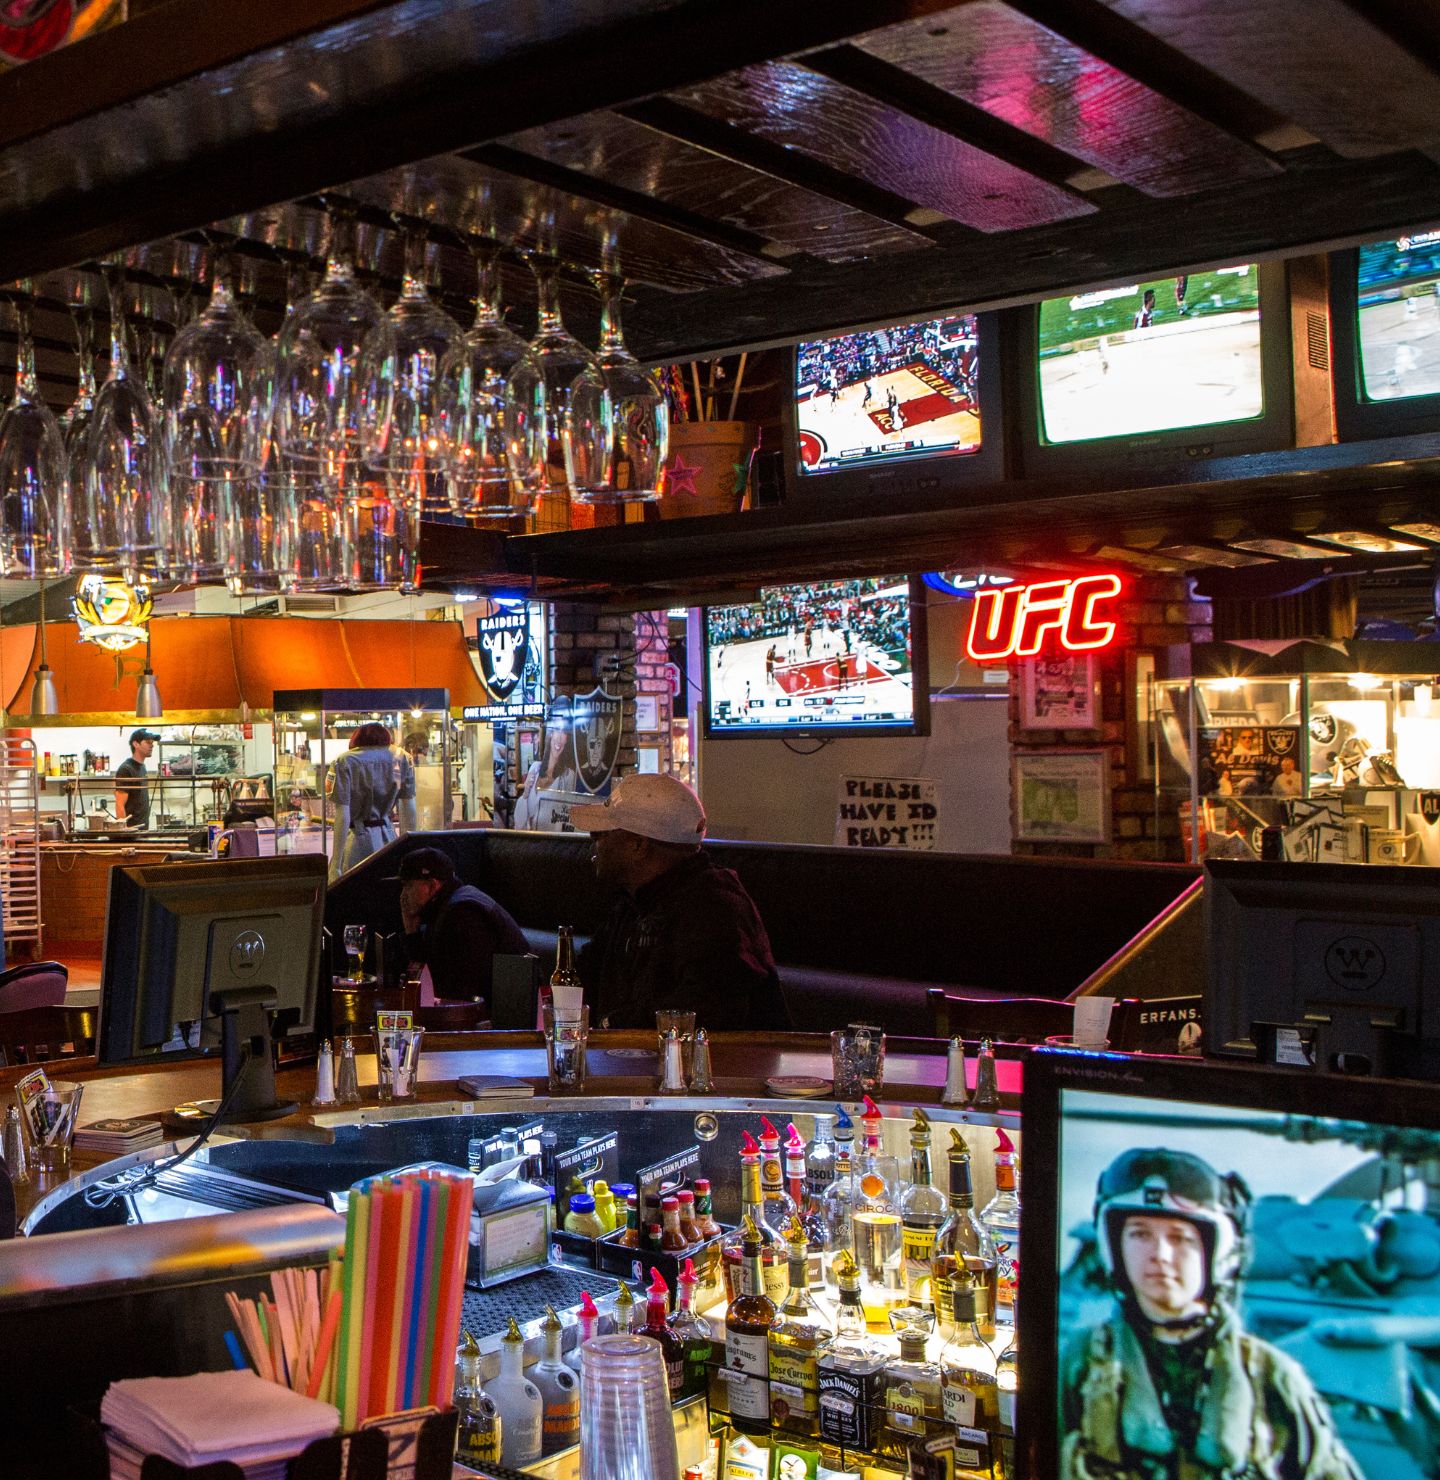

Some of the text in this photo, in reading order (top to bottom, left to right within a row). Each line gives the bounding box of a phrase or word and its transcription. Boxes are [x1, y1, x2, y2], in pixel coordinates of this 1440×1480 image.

[910, 366, 967, 403] FLORIDA
[481, 615, 526, 631] RAIDERS
[967, 574, 1122, 660] UFC
[464, 707, 479, 718] ONE
[508, 705, 523, 716] ONE
[524, 703, 543, 715] BEER
[580, 702, 617, 714] RAIDERS
[1215, 753, 1280, 766] Al Davis
[846, 780, 921, 800] PLEASE
[840, 803, 938, 821] HAVE ID
[1140, 1008, 1202, 1024] ERFANS.
[1054, 1066, 1118, 1080] ENVISION
[518, 1129, 532, 1141] PLAYS
[532, 1124, 544, 1136] HERE
[560, 1138, 616, 1169] YOUR NBA TEAM PLAYS HERE
[642, 1152, 699, 1185] YOUR NBA TEAM PLAYS HERE
[770, 1362, 813, 1380] Jose Cuervo
[819, 1378, 835, 1389] JACK
[891, 1402, 919, 1415] 1800
[469, 1432, 501, 1446] ABSO
